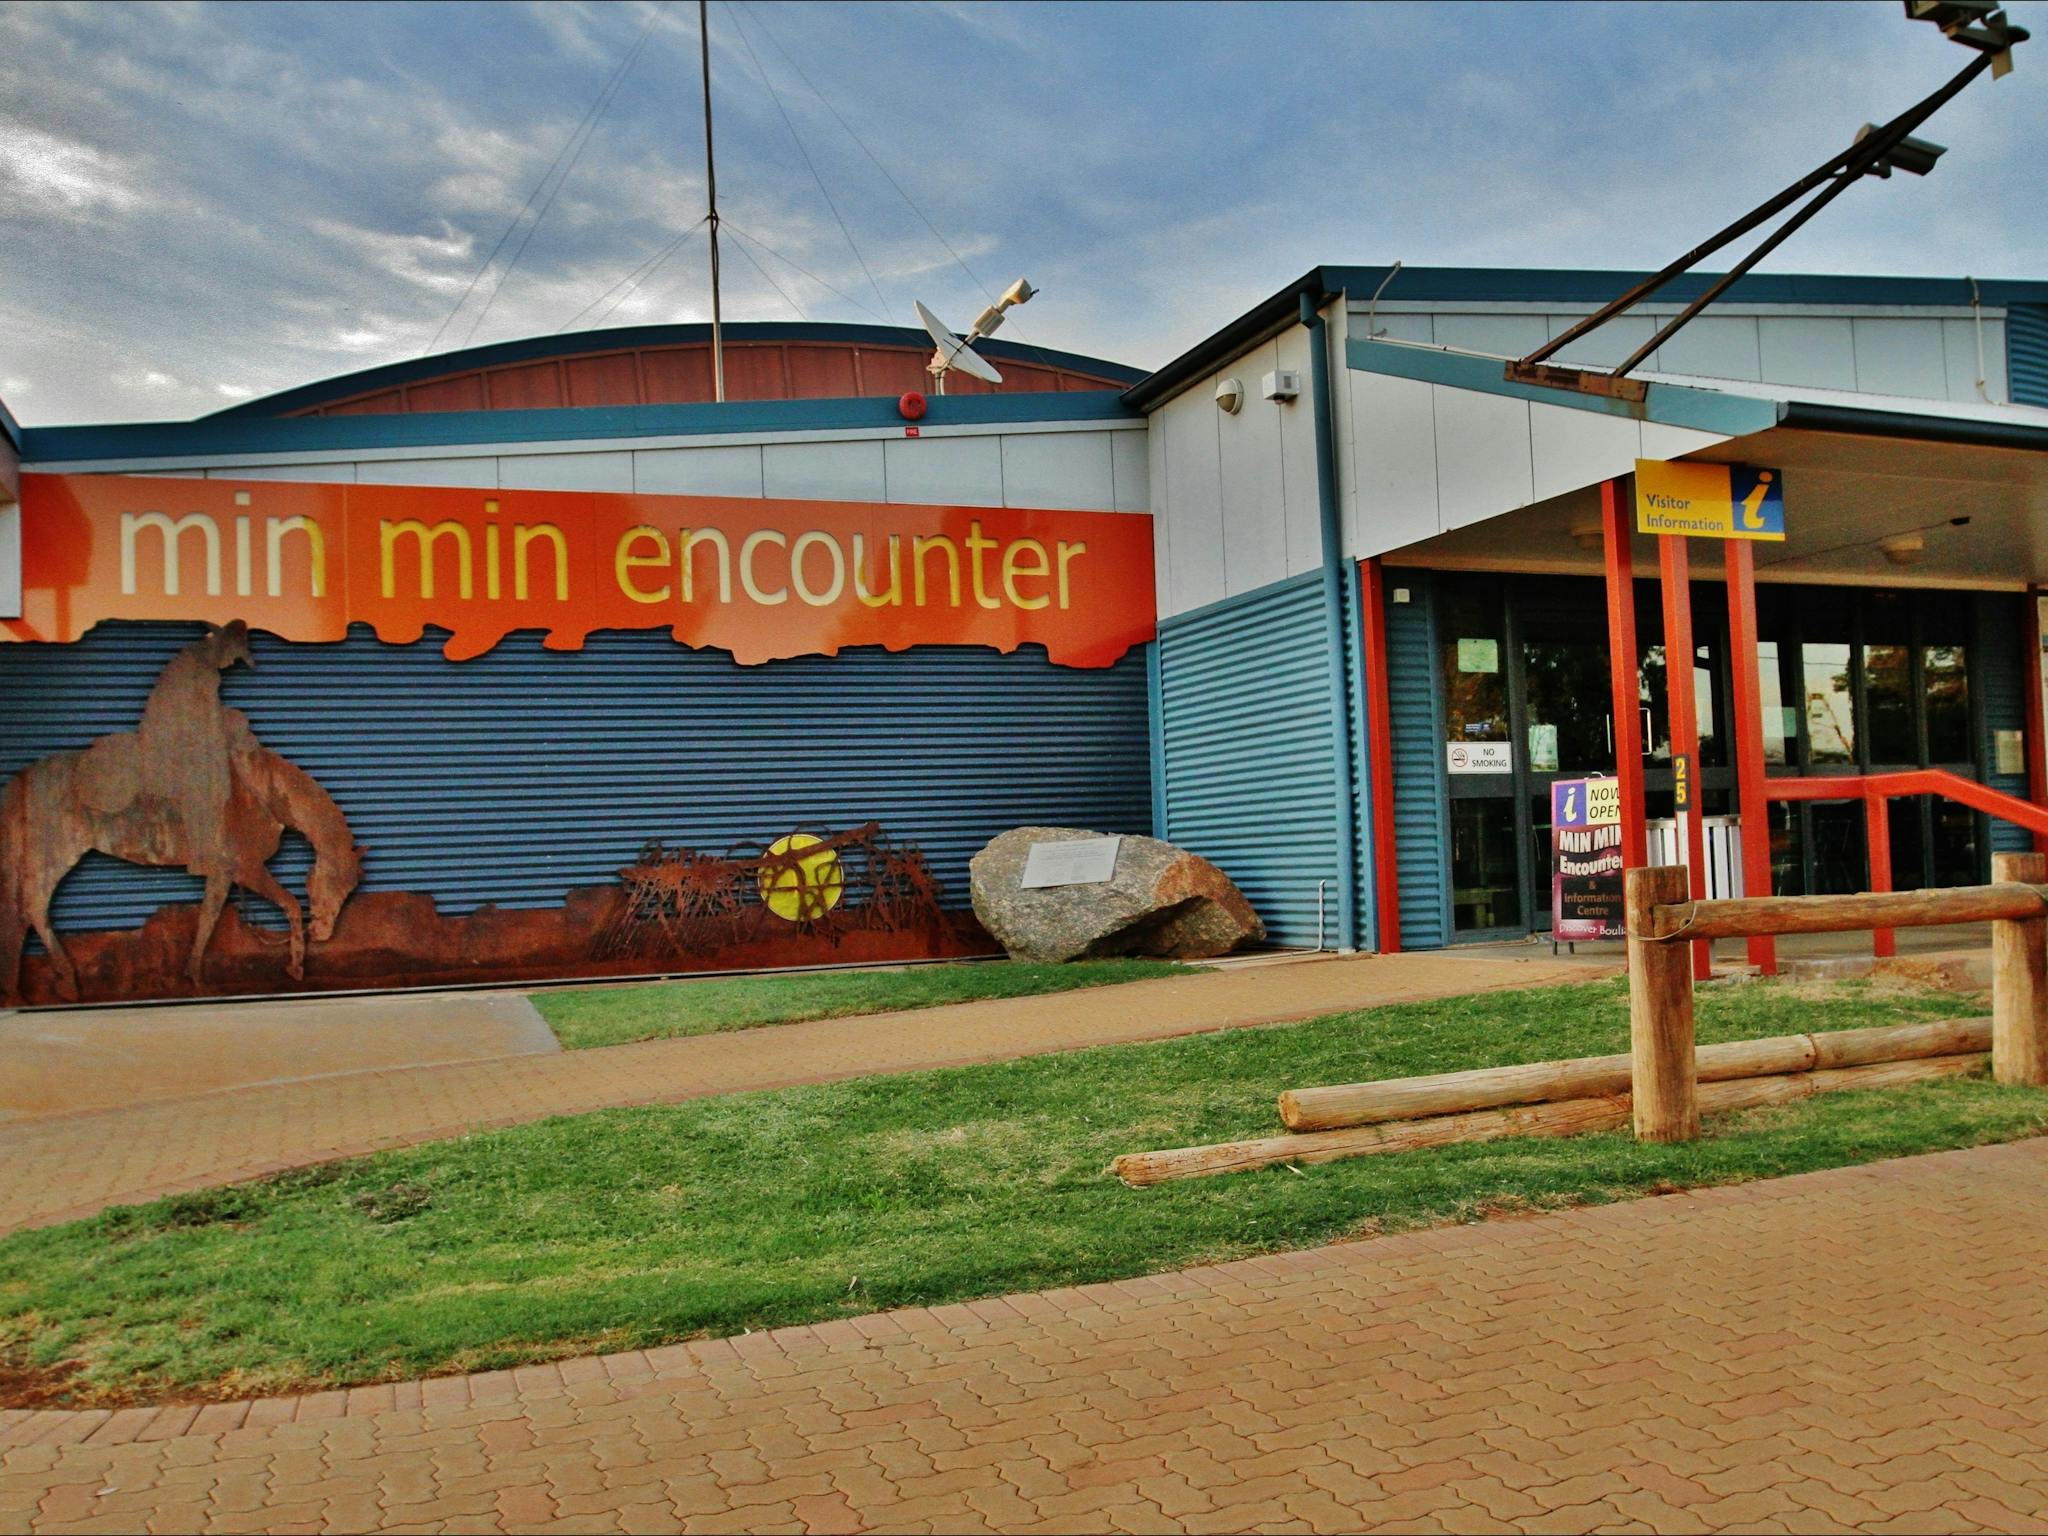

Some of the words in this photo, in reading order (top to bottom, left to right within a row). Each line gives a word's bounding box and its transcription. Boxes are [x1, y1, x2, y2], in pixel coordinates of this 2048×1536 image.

[1646, 493, 1691, 510] Visitor
[1646, 513, 1724, 532] Information
[120, 490, 326, 597] min
[379, 498, 568, 601] min
[614, 519, 1087, 610] encounter
[1482, 748, 1495, 756] NO
[1471, 759, 1507, 767] SMOKING
[1559, 830, 1592, 853] MIN
[1576, 904, 1609, 916] Centre
[1559, 923, 1598, 935] Discover
